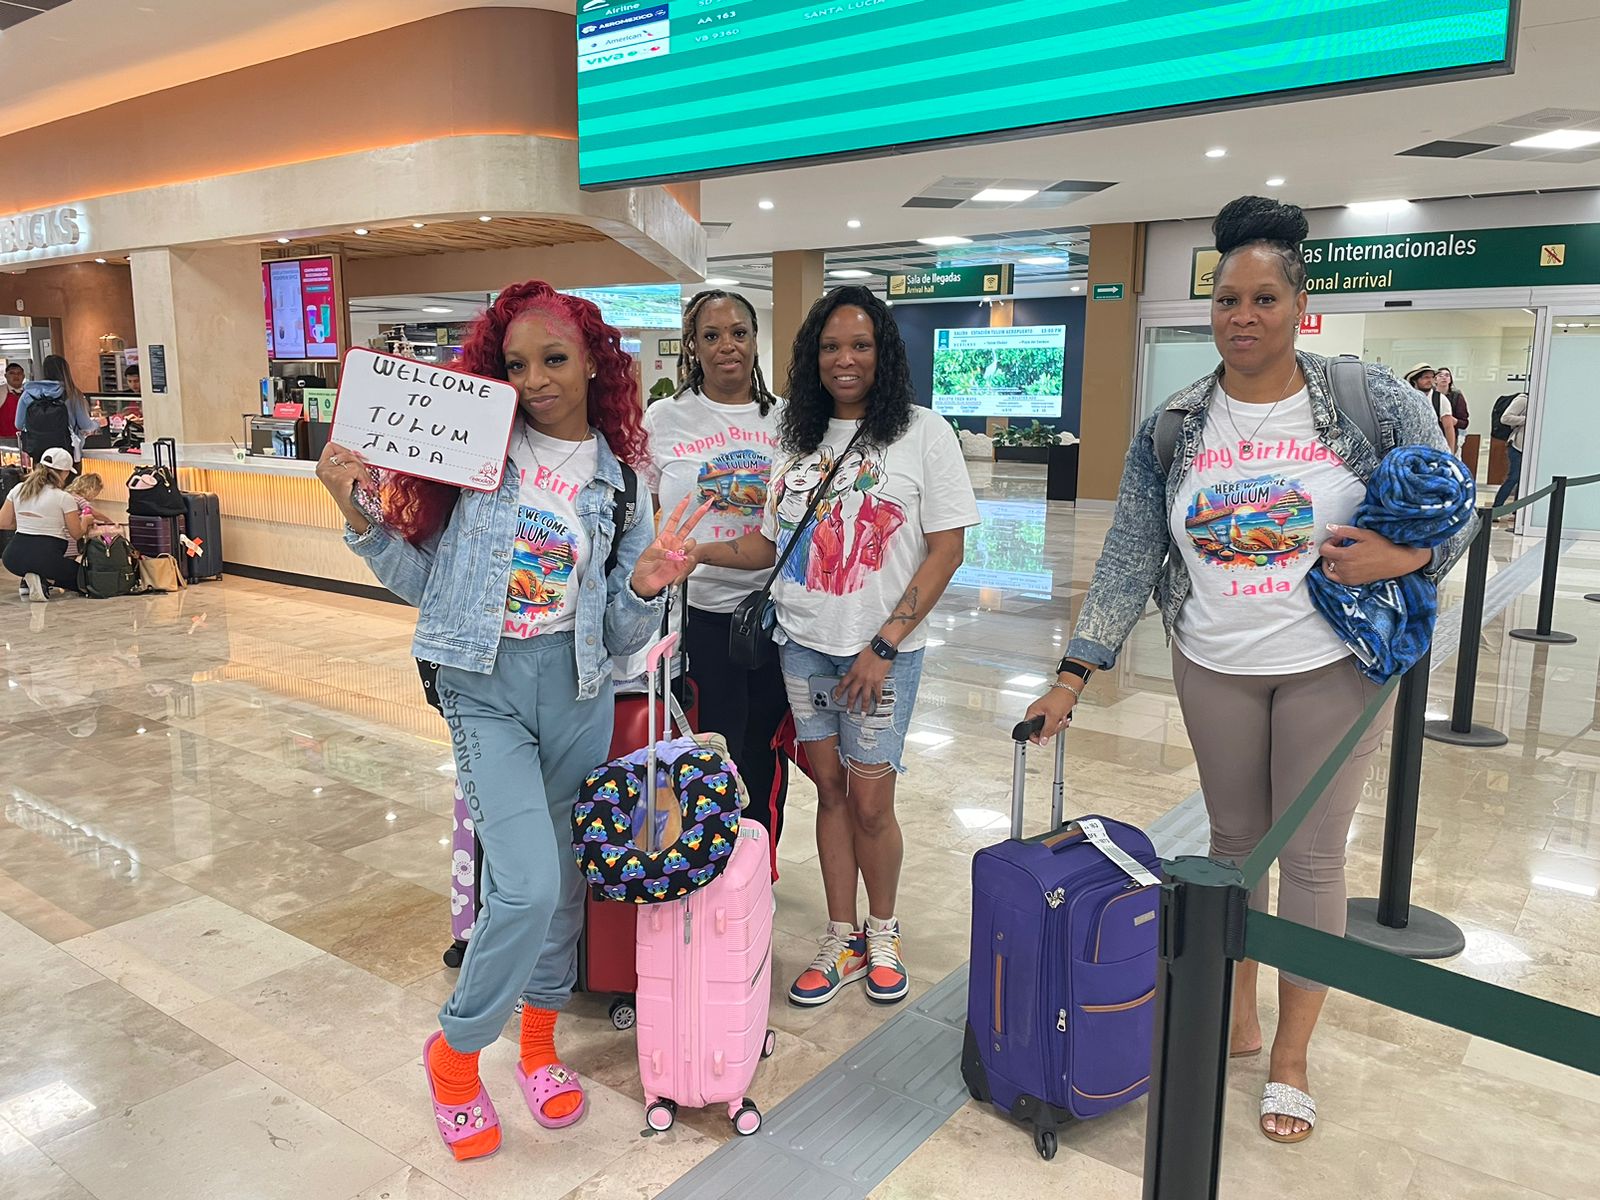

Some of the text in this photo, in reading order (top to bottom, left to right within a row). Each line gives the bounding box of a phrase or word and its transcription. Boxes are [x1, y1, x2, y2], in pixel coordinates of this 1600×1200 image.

[605, 3, 640, 16] Airline
[697, 10, 737, 25] AA 163
[803, 6, 844, 20] SANTA
[599, 13, 654, 29] AEROMEXICO
[605, 33, 642, 45] American
[711, 28, 740, 39] 9360
[1299, 234, 1477, 263] as Internacionales
[906, 271, 961, 285] Sala de llegadas
[1343, 269, 1393, 289] arrival
[906, 285, 935, 294] Arrival hall
[372, 356, 492, 398] WELCOME
[407, 393, 432, 407] TO
[368, 406, 469, 445] TULUM
[362, 432, 444, 464] JADA
[672, 431, 726, 457] Happy
[726, 460, 758, 469] TULUM
[1223, 486, 1270, 507] TULUM
[523, 509, 539, 526] WE
[541, 516, 569, 537] COME
[711, 525, 736, 538] To
[1222, 576, 1291, 597] Jada
[464, 780, 485, 824] LOS
